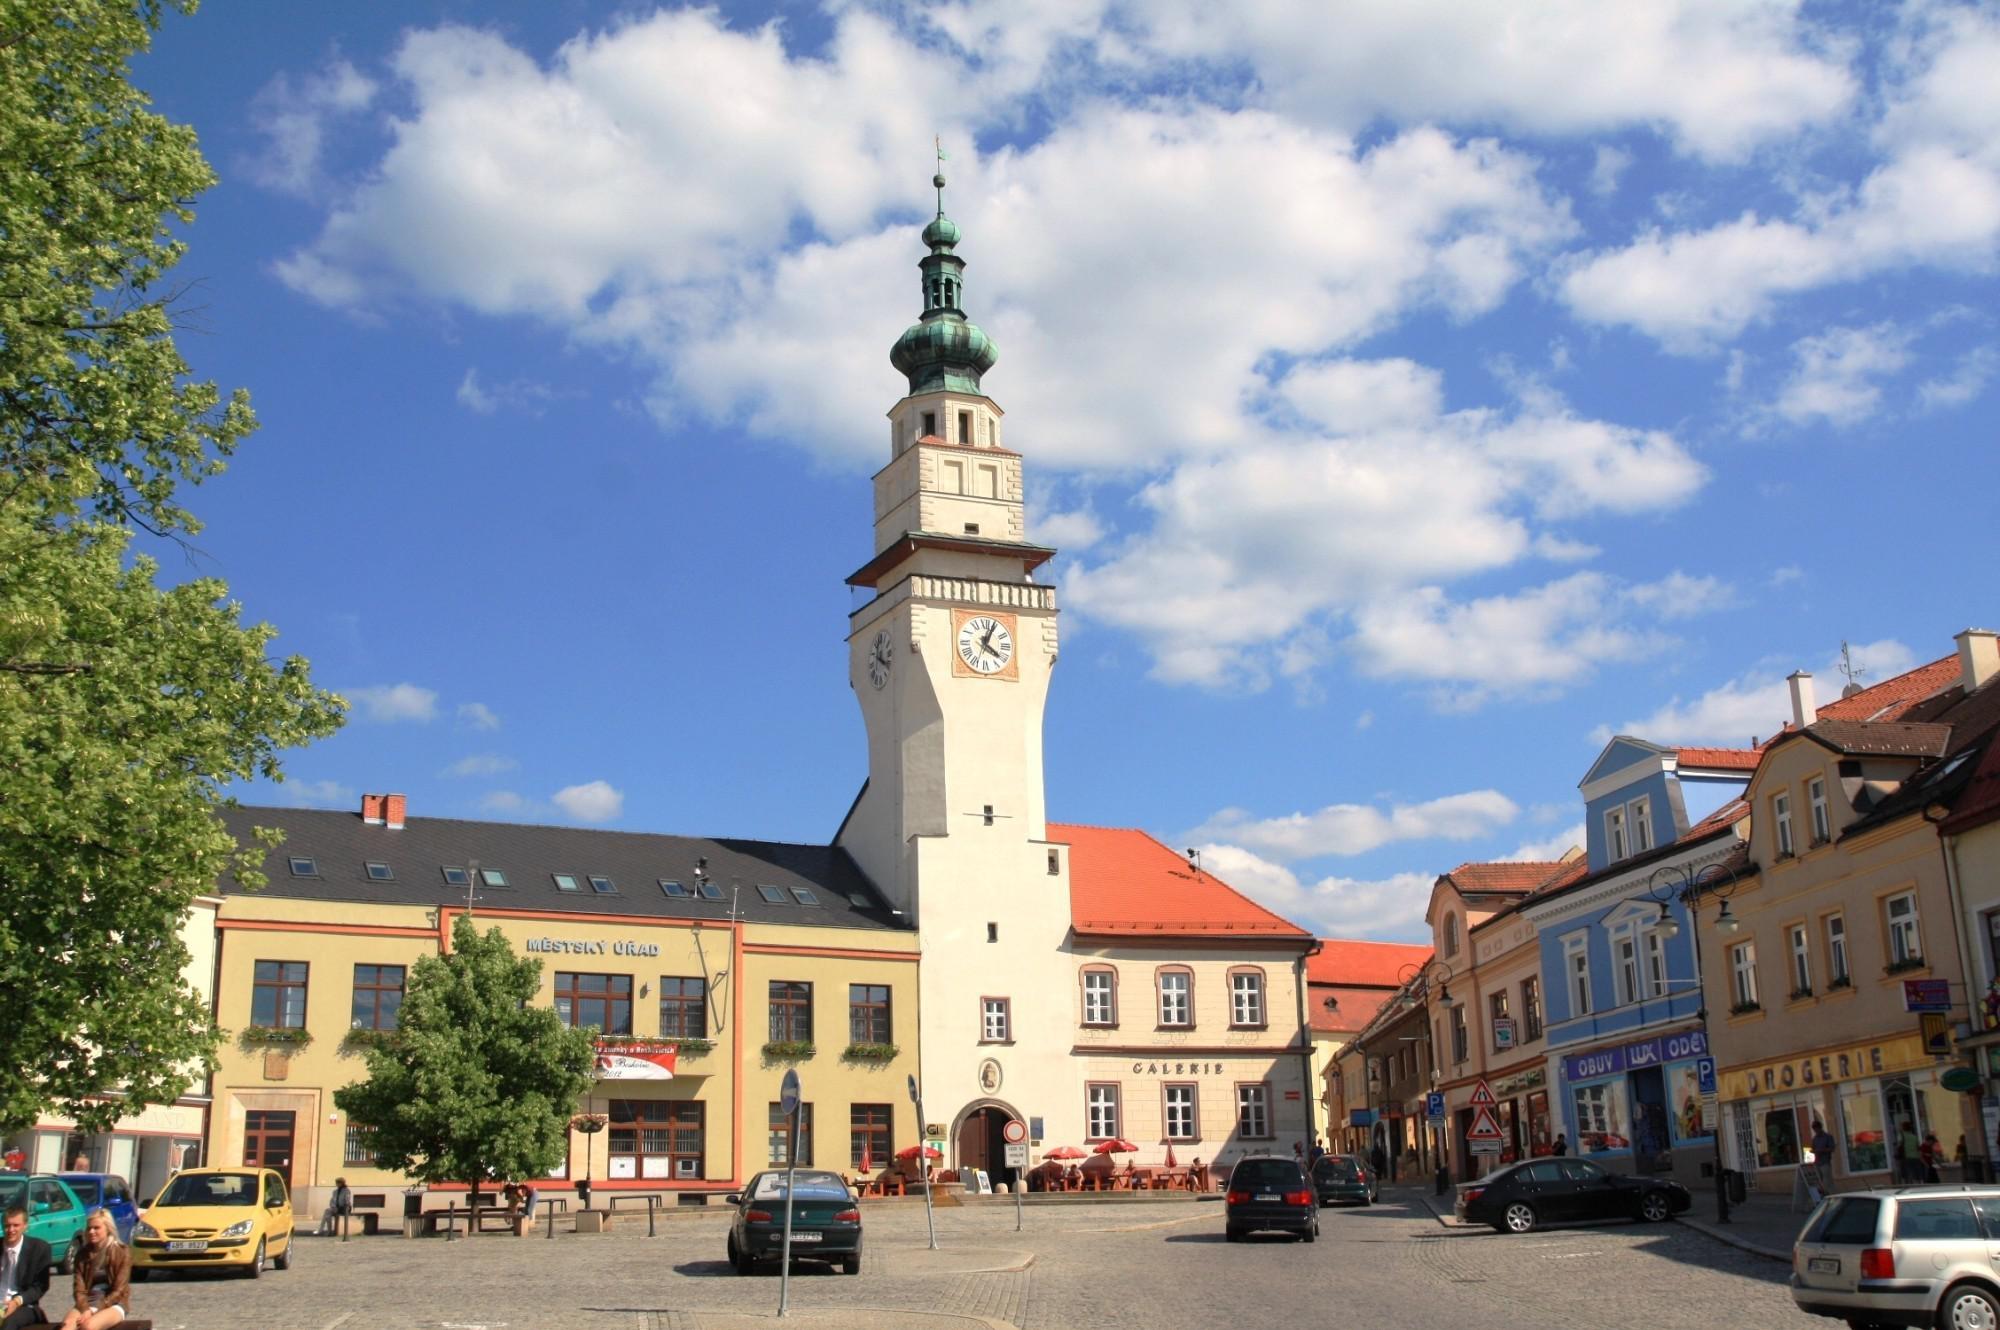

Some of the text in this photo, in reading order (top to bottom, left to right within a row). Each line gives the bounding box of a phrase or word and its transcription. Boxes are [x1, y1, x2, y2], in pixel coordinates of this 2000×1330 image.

[527, 937, 608, 954] MĚSTSKÝ
[1132, 1062, 1225, 1075] GALERIE
[1578, 1053, 1613, 1076] OBUV
[1630, 1043, 1657, 1065] LUX
[1701, 1062, 1712, 1082] P
[1747, 1047, 1883, 1093] DROGERIE
[1430, 1095, 1440, 1109] P
